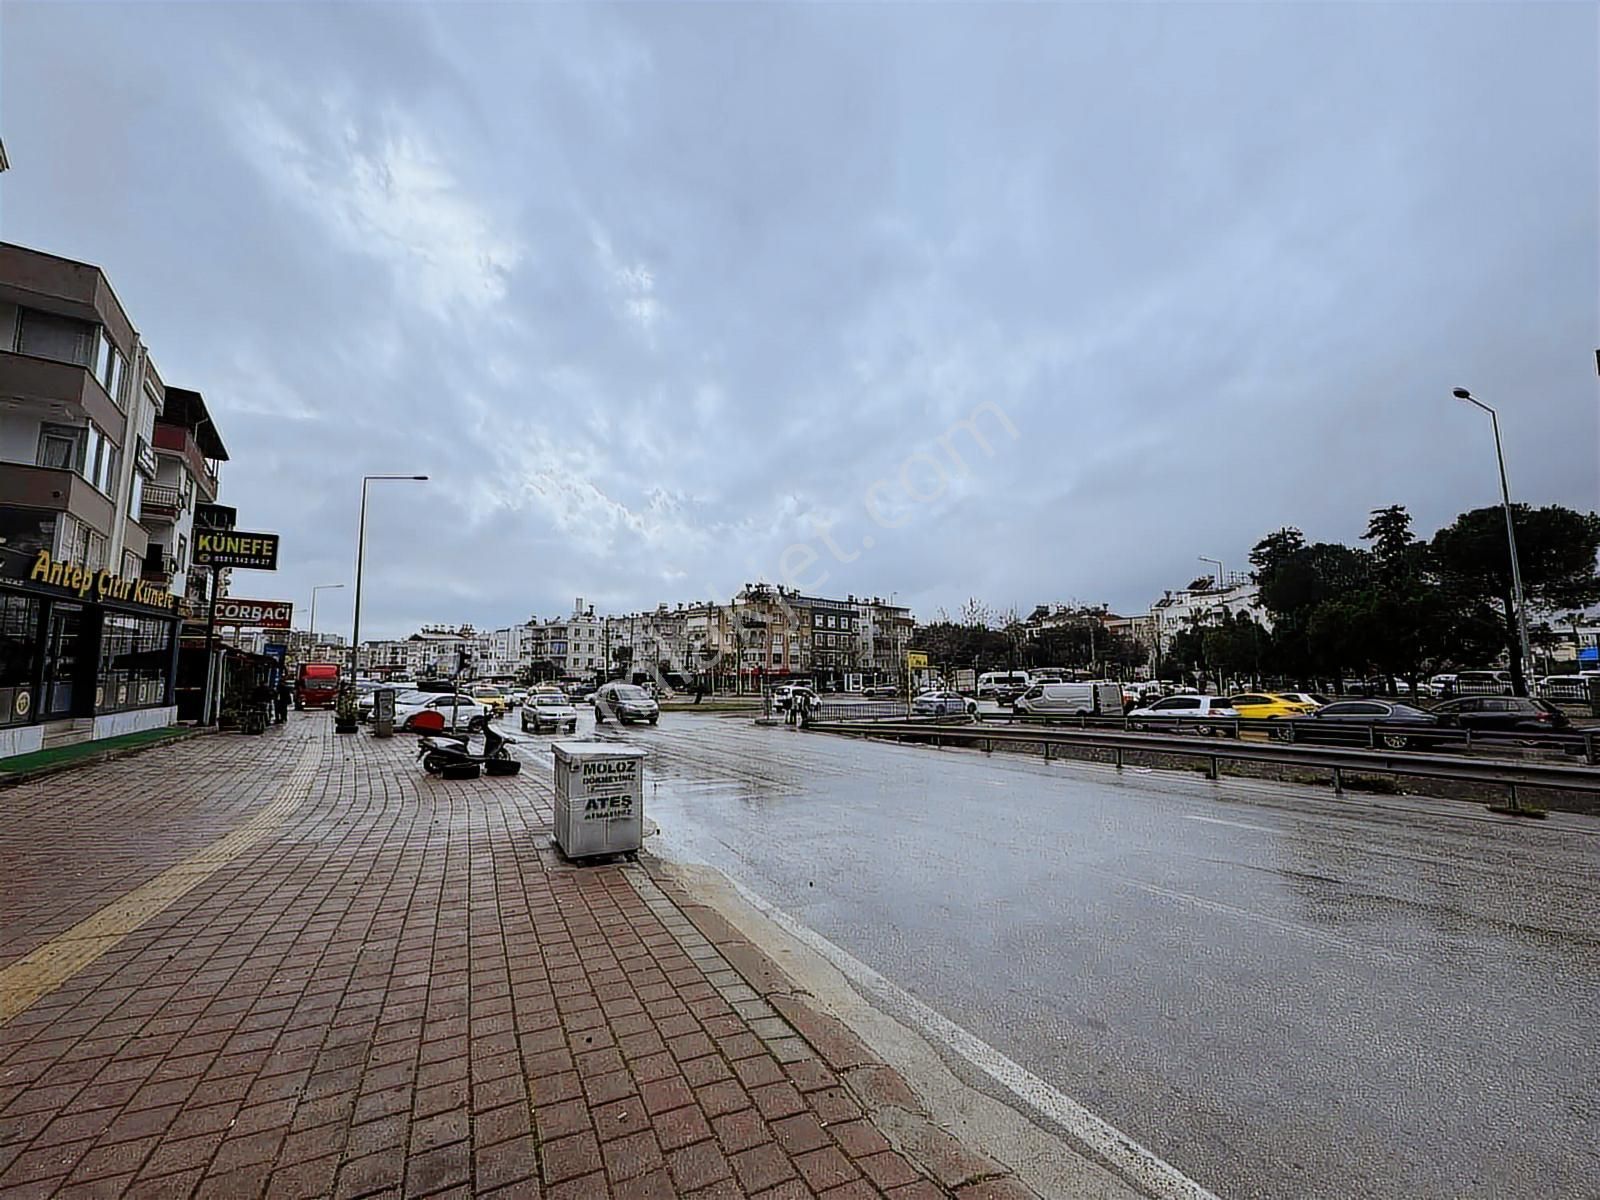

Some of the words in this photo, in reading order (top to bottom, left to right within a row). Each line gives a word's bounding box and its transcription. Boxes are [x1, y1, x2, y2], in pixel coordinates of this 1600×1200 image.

[198, 532, 274, 556] KÜNEFE
[30, 549, 93, 597] Antep
[133, 578, 174, 609] Künefe
[583, 761, 637, 776] MOLOZ
[585, 795, 633, 811] ATEŞ
